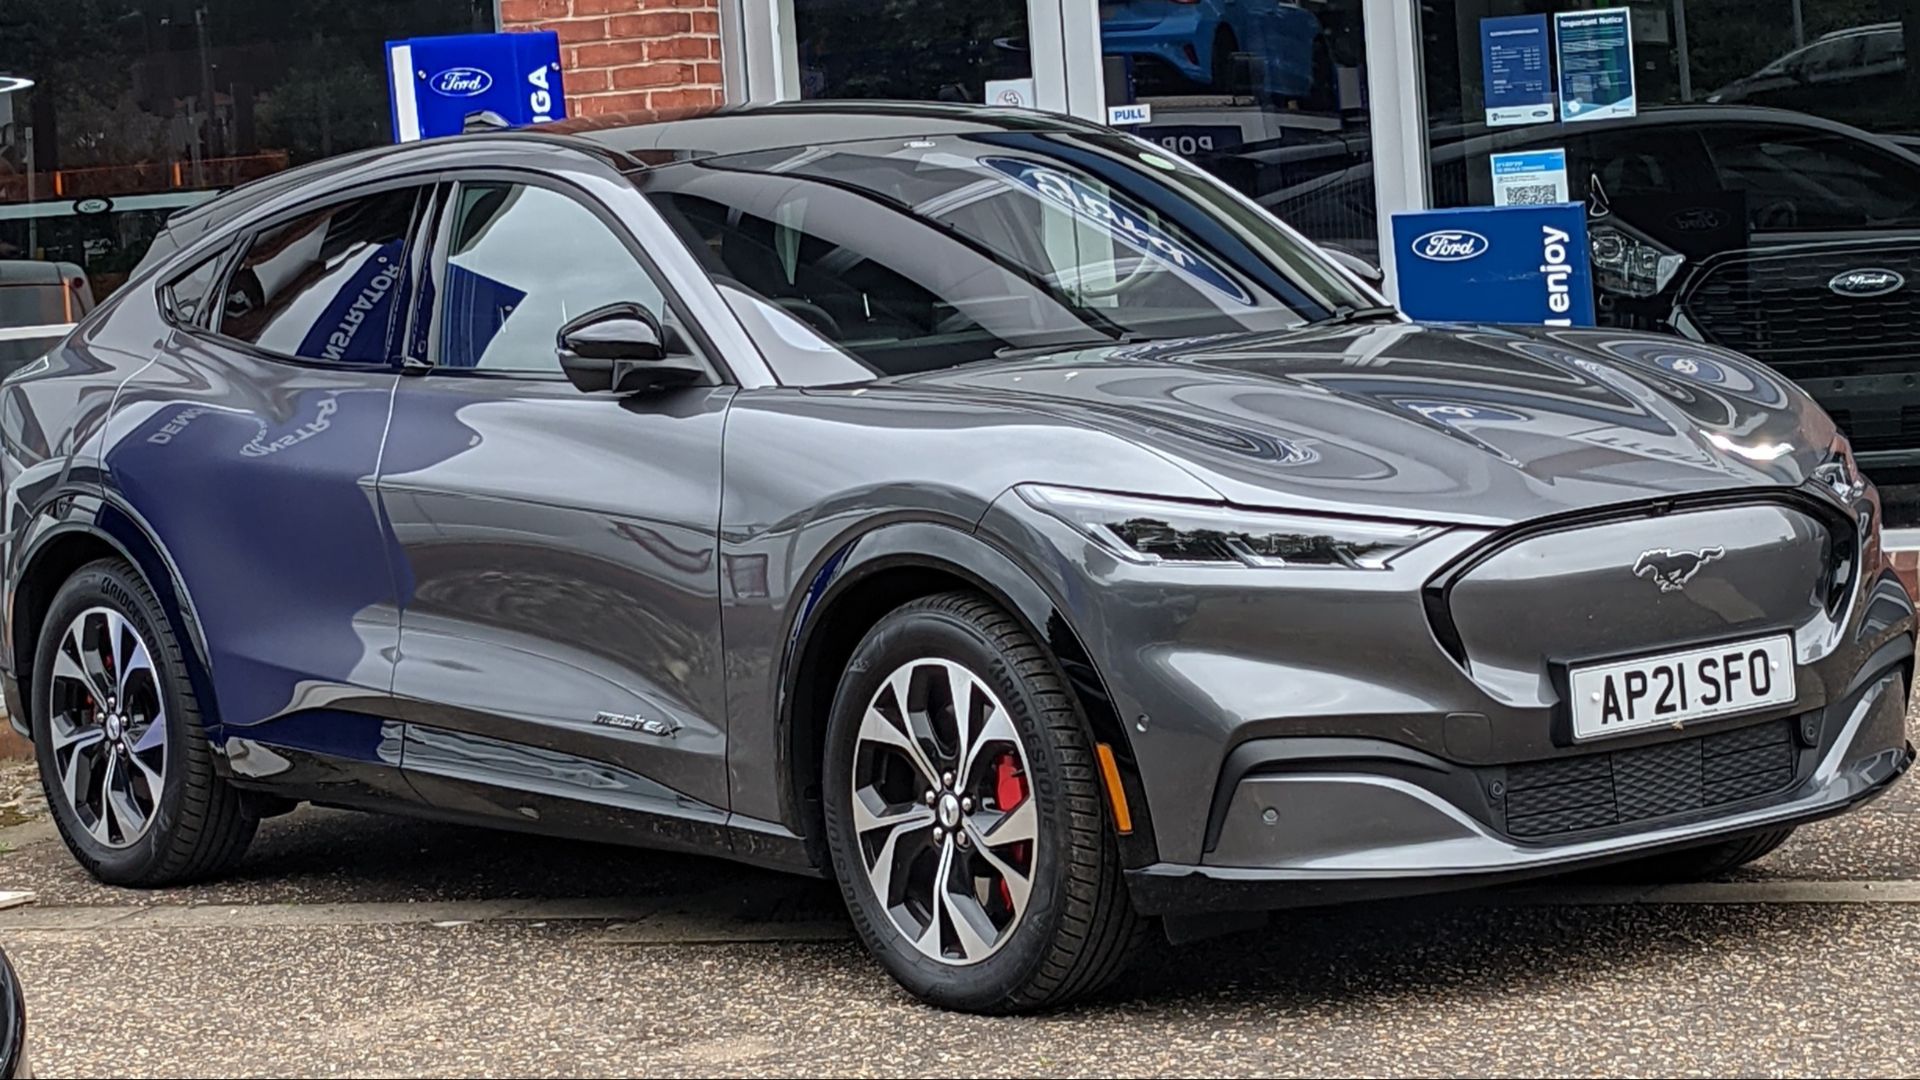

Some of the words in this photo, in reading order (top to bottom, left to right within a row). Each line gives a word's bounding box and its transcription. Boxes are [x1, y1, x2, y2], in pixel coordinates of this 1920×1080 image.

[1560, 18, 1598, 28] Important
[1599, 16, 1624, 25] Notice
[440, 71, 482, 91] Ford
[1114, 109, 1146, 121] PULL
[1425, 234, 1476, 257] Ford
[1540, 225, 1573, 313] enjoy
[1600, 662, 1688, 725] AP21
[1698, 648, 1771, 706] SFO
